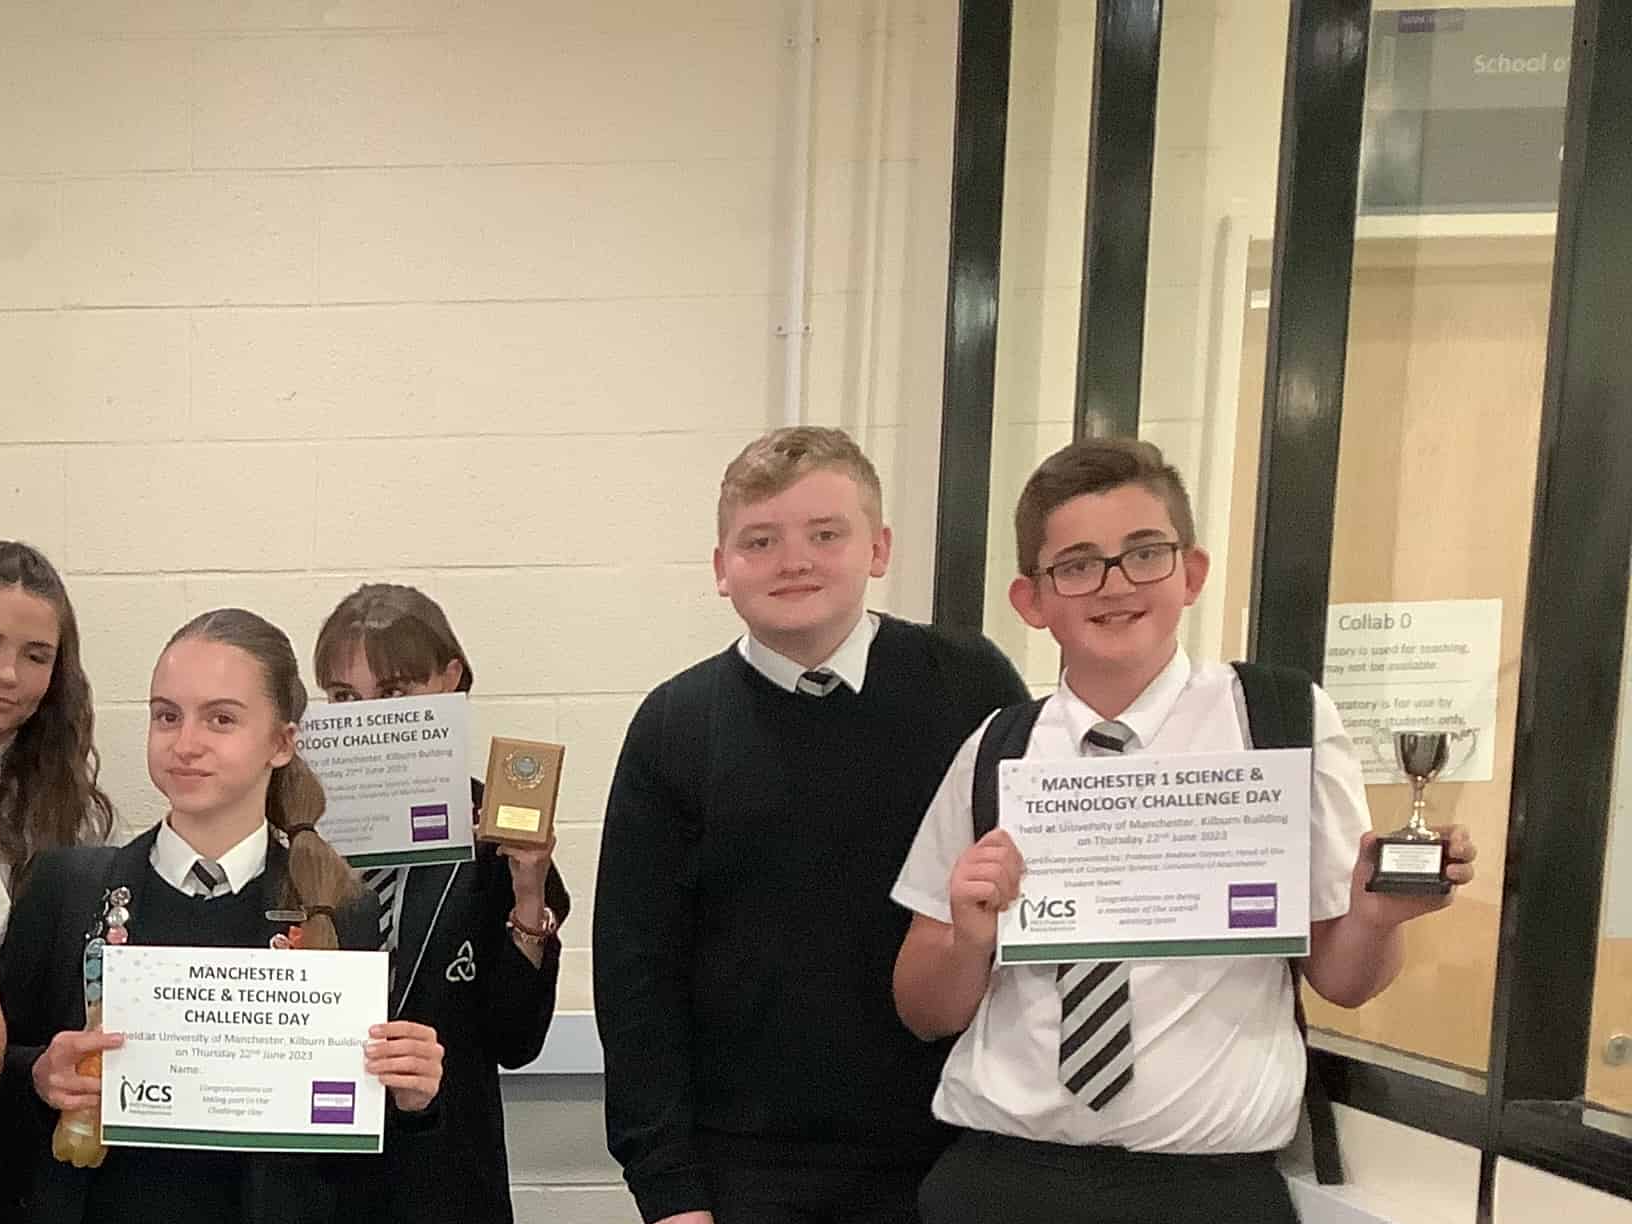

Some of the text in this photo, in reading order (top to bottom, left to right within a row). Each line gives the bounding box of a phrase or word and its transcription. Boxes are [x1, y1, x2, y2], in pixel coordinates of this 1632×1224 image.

[1473, 53, 1547, 74] School
[1338, 612, 1395, 631] Collab
[304, 709, 435, 732] HESTER 1 SCIENCE &
[342, 731, 418, 747] CHALLENGE
[422, 727, 450, 741] DAY
[1041, 767, 1264, 792] MANCHESTER 1 SCIENCE &
[1025, 788, 1282, 814] TECHNOLOGY CHALLENGE DAY
[1019, 892, 1077, 932] MCS
[188, 966, 308, 982] MANCHESTER 1
[153, 986, 343, 1005] SCIENCE & TECHNOLOGY
[184, 1009, 311, 1026] CHALLENGE DAY
[159, 1032, 208, 1044] University
[289, 1035, 325, 1047] Kilburn
[175, 1049, 189, 1057] on
[191, 1047, 236, 1059] Thursday
[263, 1050, 286, 1060] June
[288, 1051, 313, 1061] 2023
[119, 1074, 173, 1113] MCS
